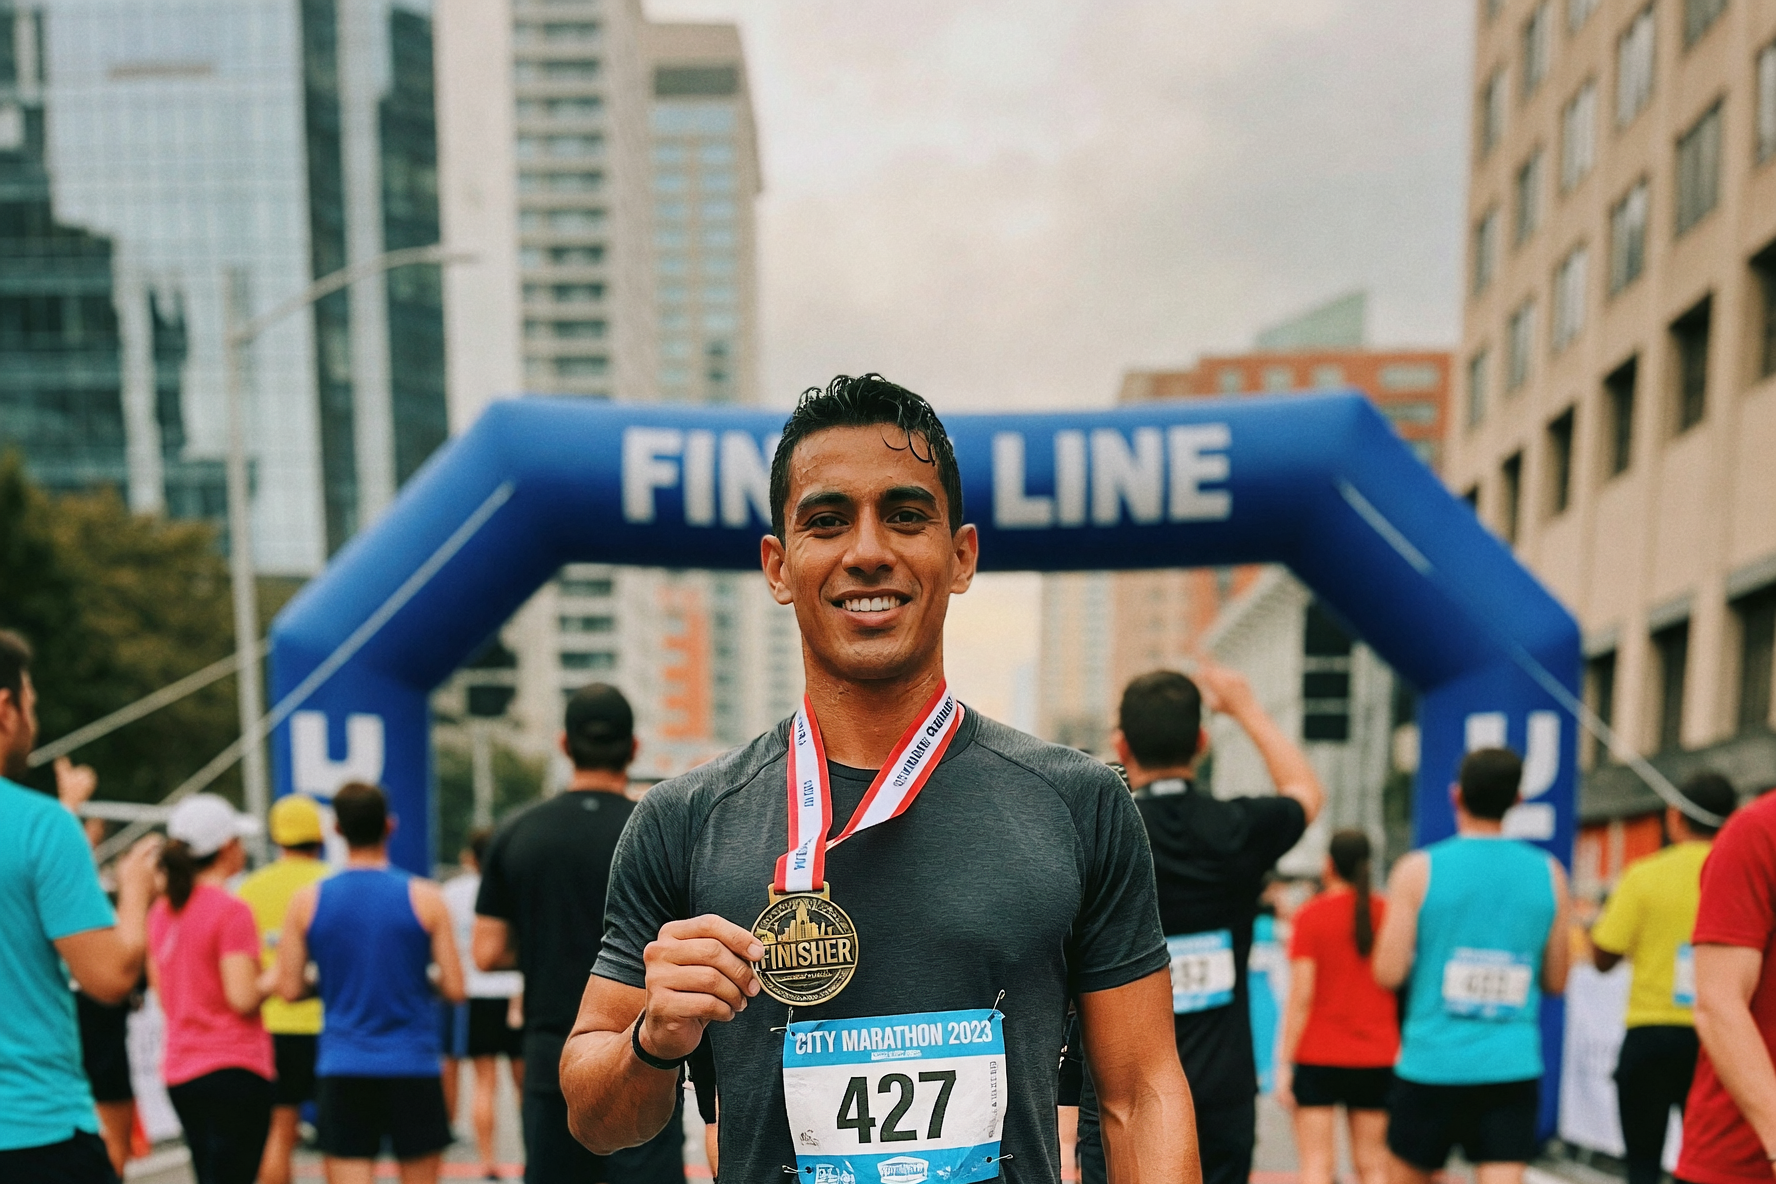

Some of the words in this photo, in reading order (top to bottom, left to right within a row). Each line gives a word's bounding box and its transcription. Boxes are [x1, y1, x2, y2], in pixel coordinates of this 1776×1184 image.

[622, 426, 782, 530] FIN
[992, 422, 1232, 530] LINE
[760, 938, 854, 970] FINISHER
[795, 1030, 836, 1055] CITY
[842, 1022, 944, 1052] MARATHON
[947, 1019, 994, 1046] 2023
[836, 1069, 957, 1144] 427
